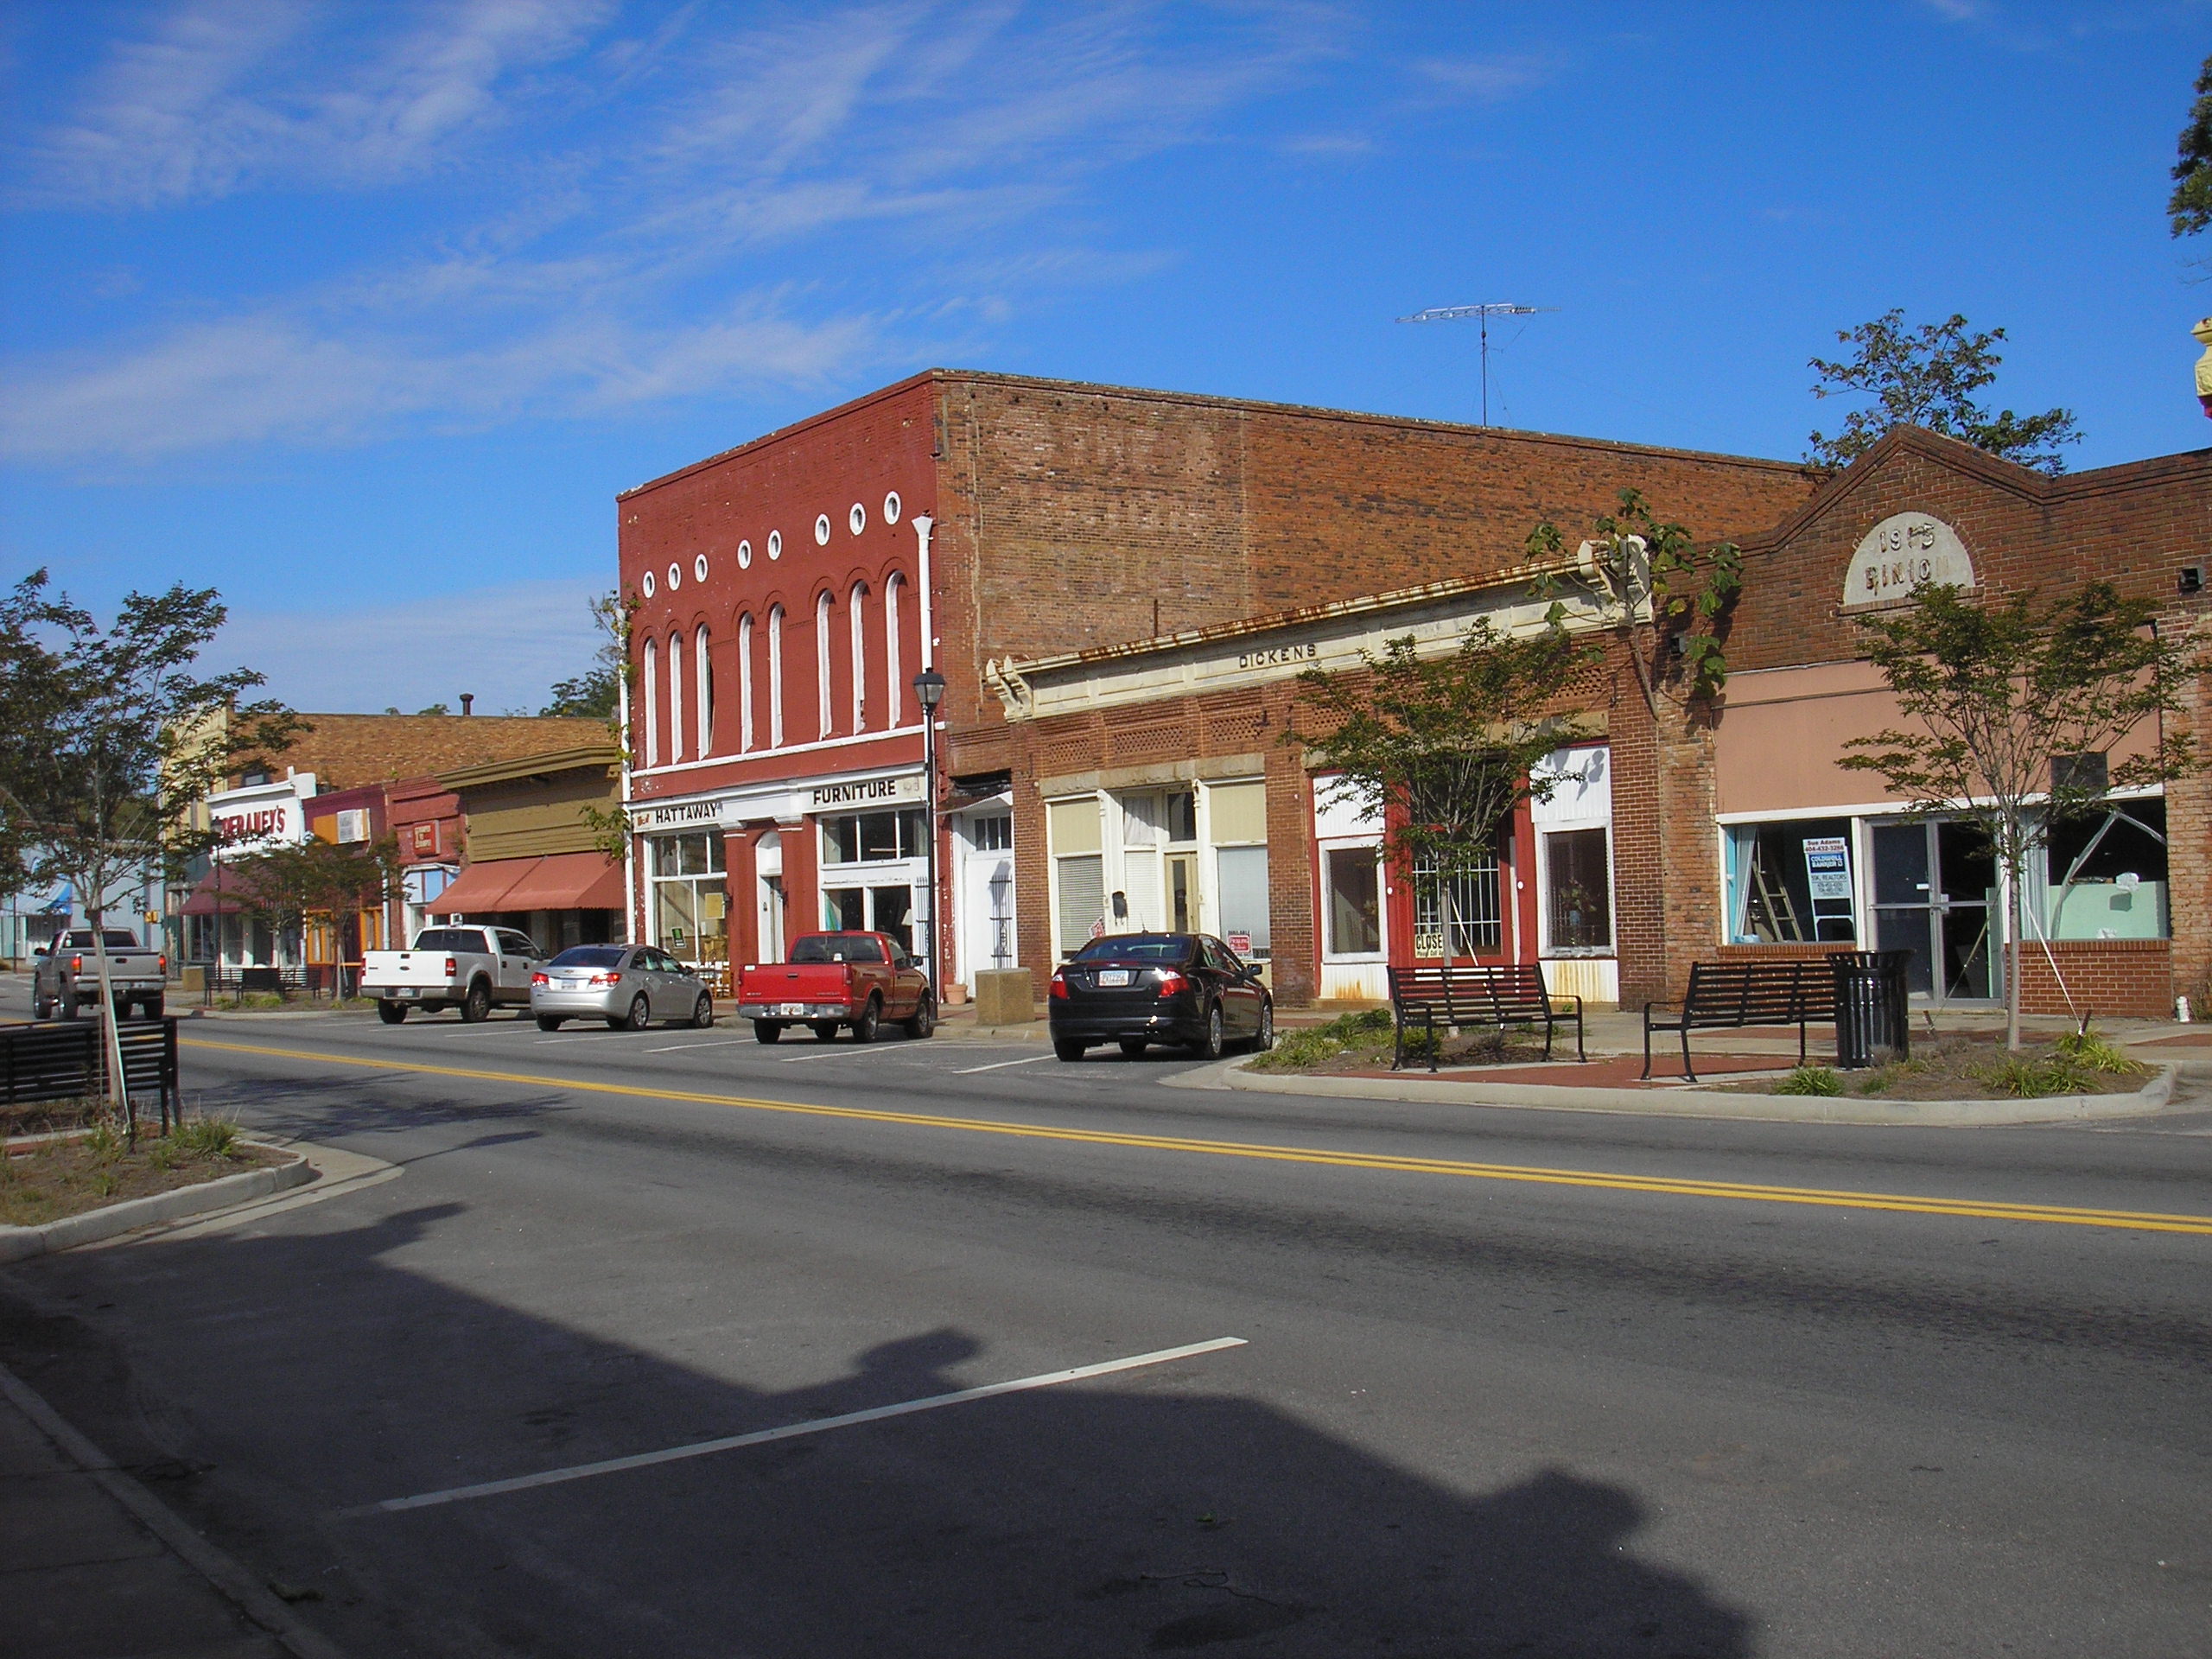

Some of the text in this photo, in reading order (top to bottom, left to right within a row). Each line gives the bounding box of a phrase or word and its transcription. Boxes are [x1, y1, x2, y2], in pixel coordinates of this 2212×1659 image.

[1239, 644, 1316, 668] DICKENS
[813, 779, 897, 805] FURNITURE
[656, 803, 718, 823] HATTAWAY
[1416, 934, 1443, 950] CLOSE
